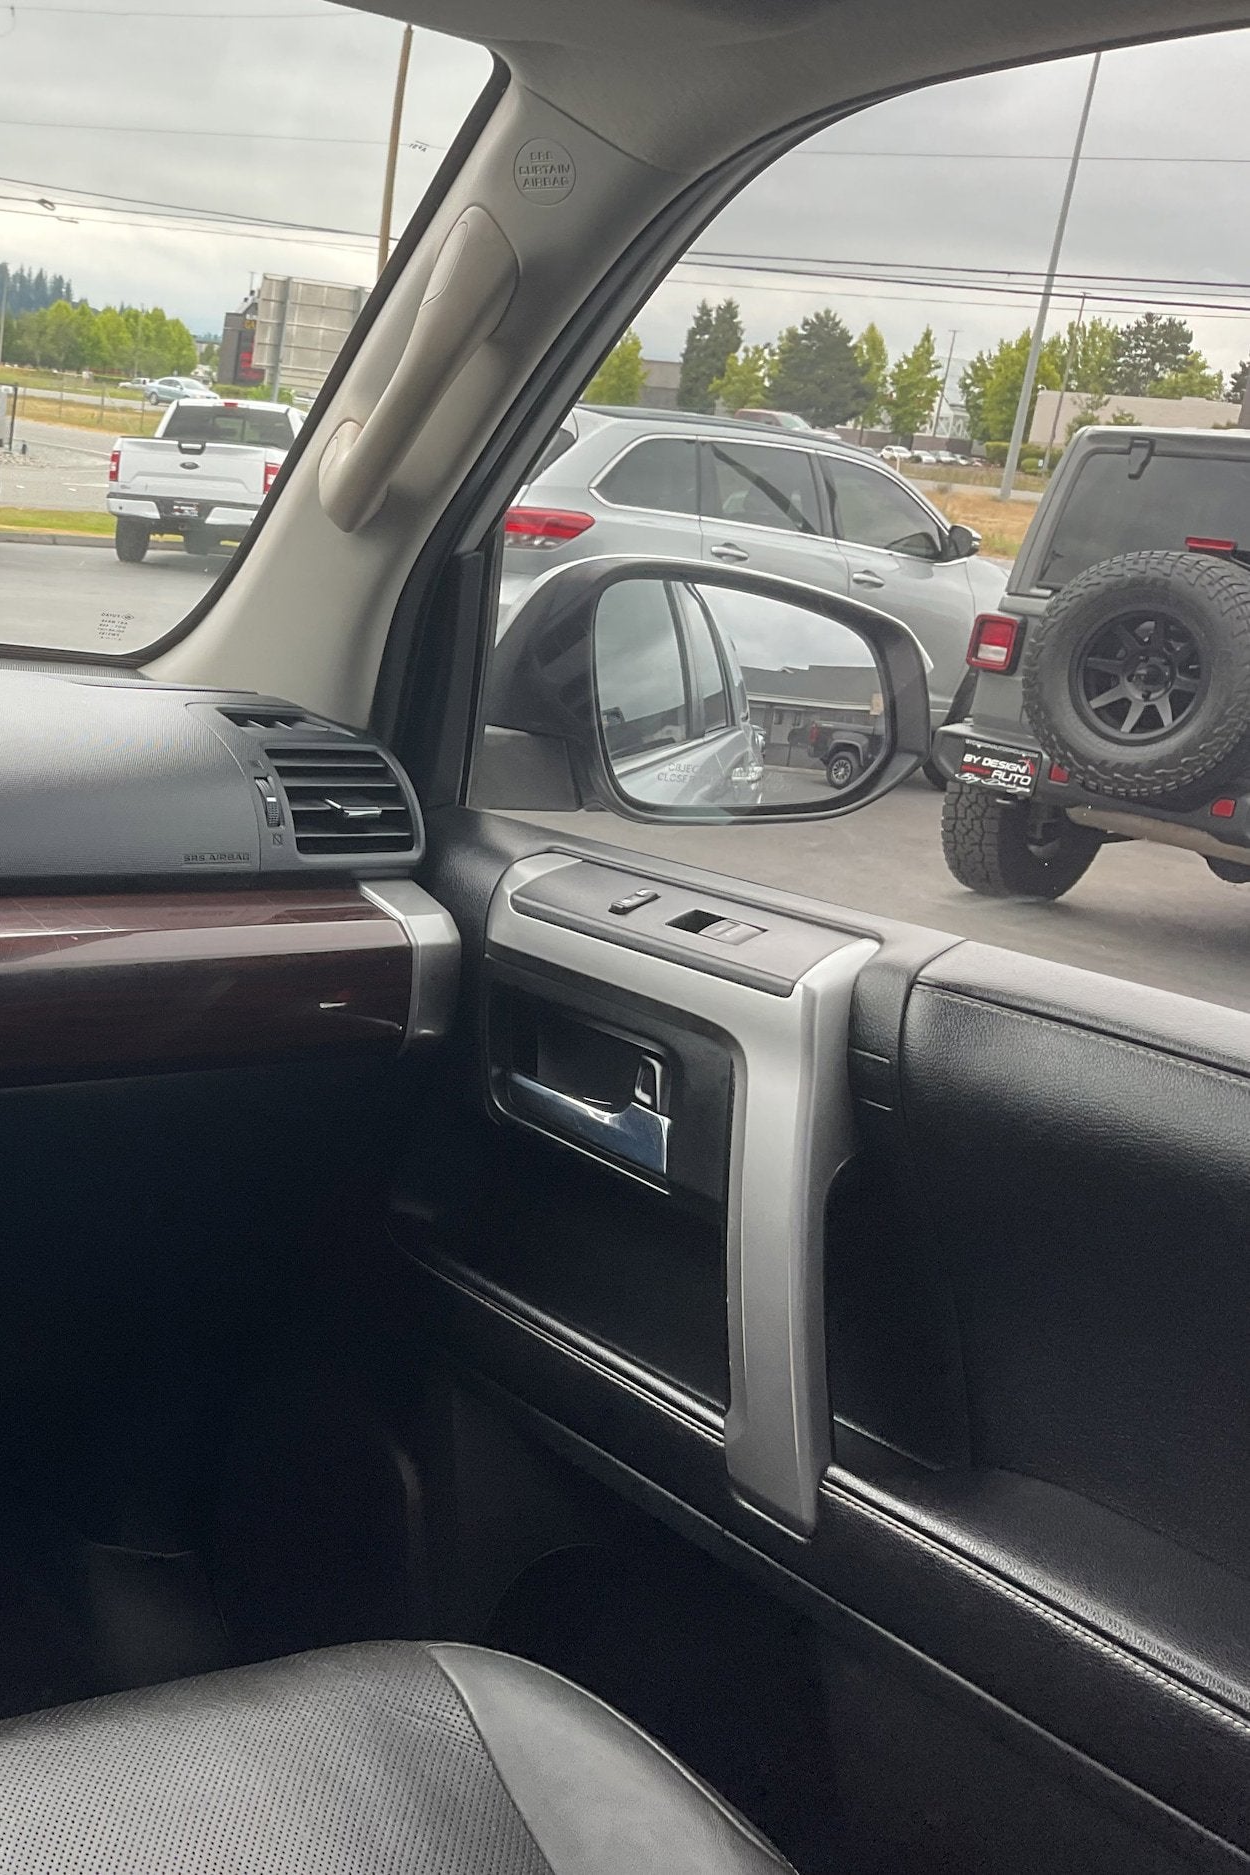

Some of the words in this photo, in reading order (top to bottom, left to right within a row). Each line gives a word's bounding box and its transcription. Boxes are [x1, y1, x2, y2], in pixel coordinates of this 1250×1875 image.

[519, 164, 570, 175] CURTAIN
[523, 176, 569, 188] AIRBAG
[668, 761, 701, 772] OBJEC
[963, 753, 981, 764] BY
[981, 757, 1028, 774] DESIGN
[991, 769, 1031, 786] AUTO
[210, 853, 250, 861] AIRBAG
